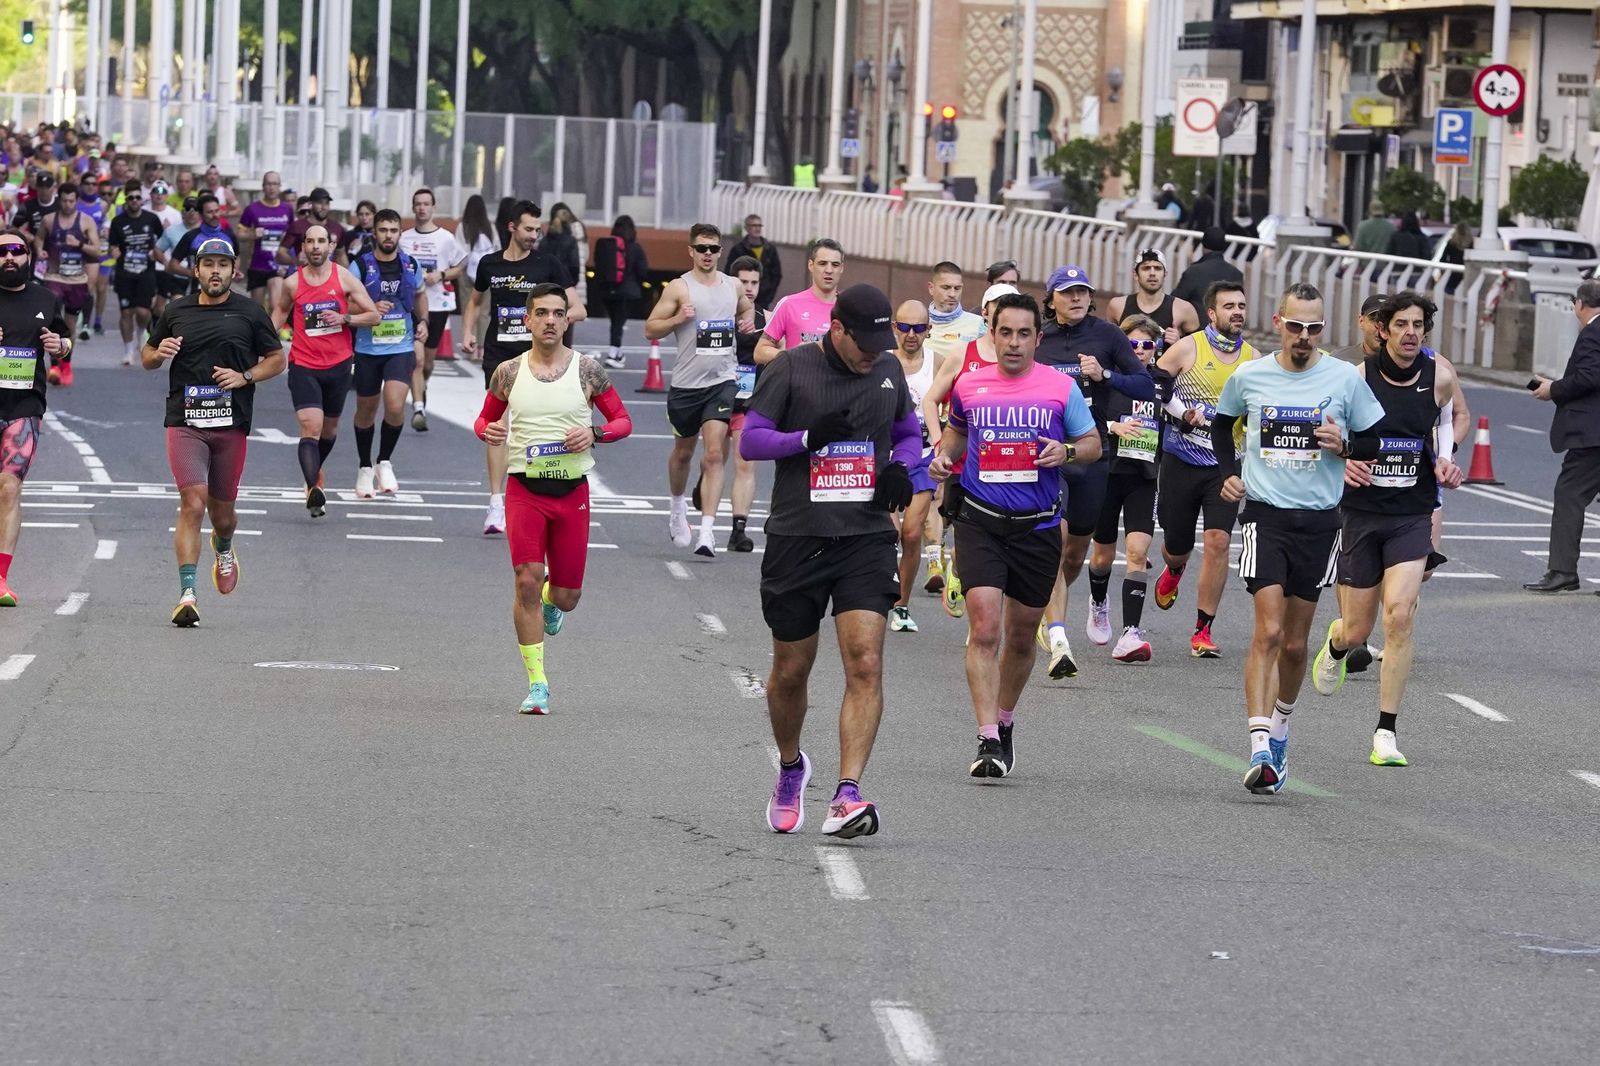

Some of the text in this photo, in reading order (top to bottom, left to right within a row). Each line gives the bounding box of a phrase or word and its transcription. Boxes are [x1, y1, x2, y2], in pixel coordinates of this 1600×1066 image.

[1439, 113, 1464, 144] P
[490, 275, 516, 284] Sports
[506, 325, 527, 334] JORDI
[710, 339, 722, 347] ALI
[1132, 400, 1155, 416] DKR
[185, 408, 232, 419] FREDERICO
[971, 405, 1053, 430] VILLALÓN
[1281, 409, 1315, 418] ZURICH
[1282, 425, 1301, 434] 4160
[998, 431, 1031, 440] ZURICH
[1273, 435, 1309, 448] GOTYF
[542, 444, 569, 454] ZURIC
[832, 445, 867, 454] ZURICH
[1000, 447, 1014, 456] 925
[1386, 455, 1403, 463] 4648
[545, 460, 561, 468] 2657
[834, 462, 854, 472] 1390
[1370, 464, 1417, 476] TRUJILLO
[816, 473, 871, 488] AUGUSTO
